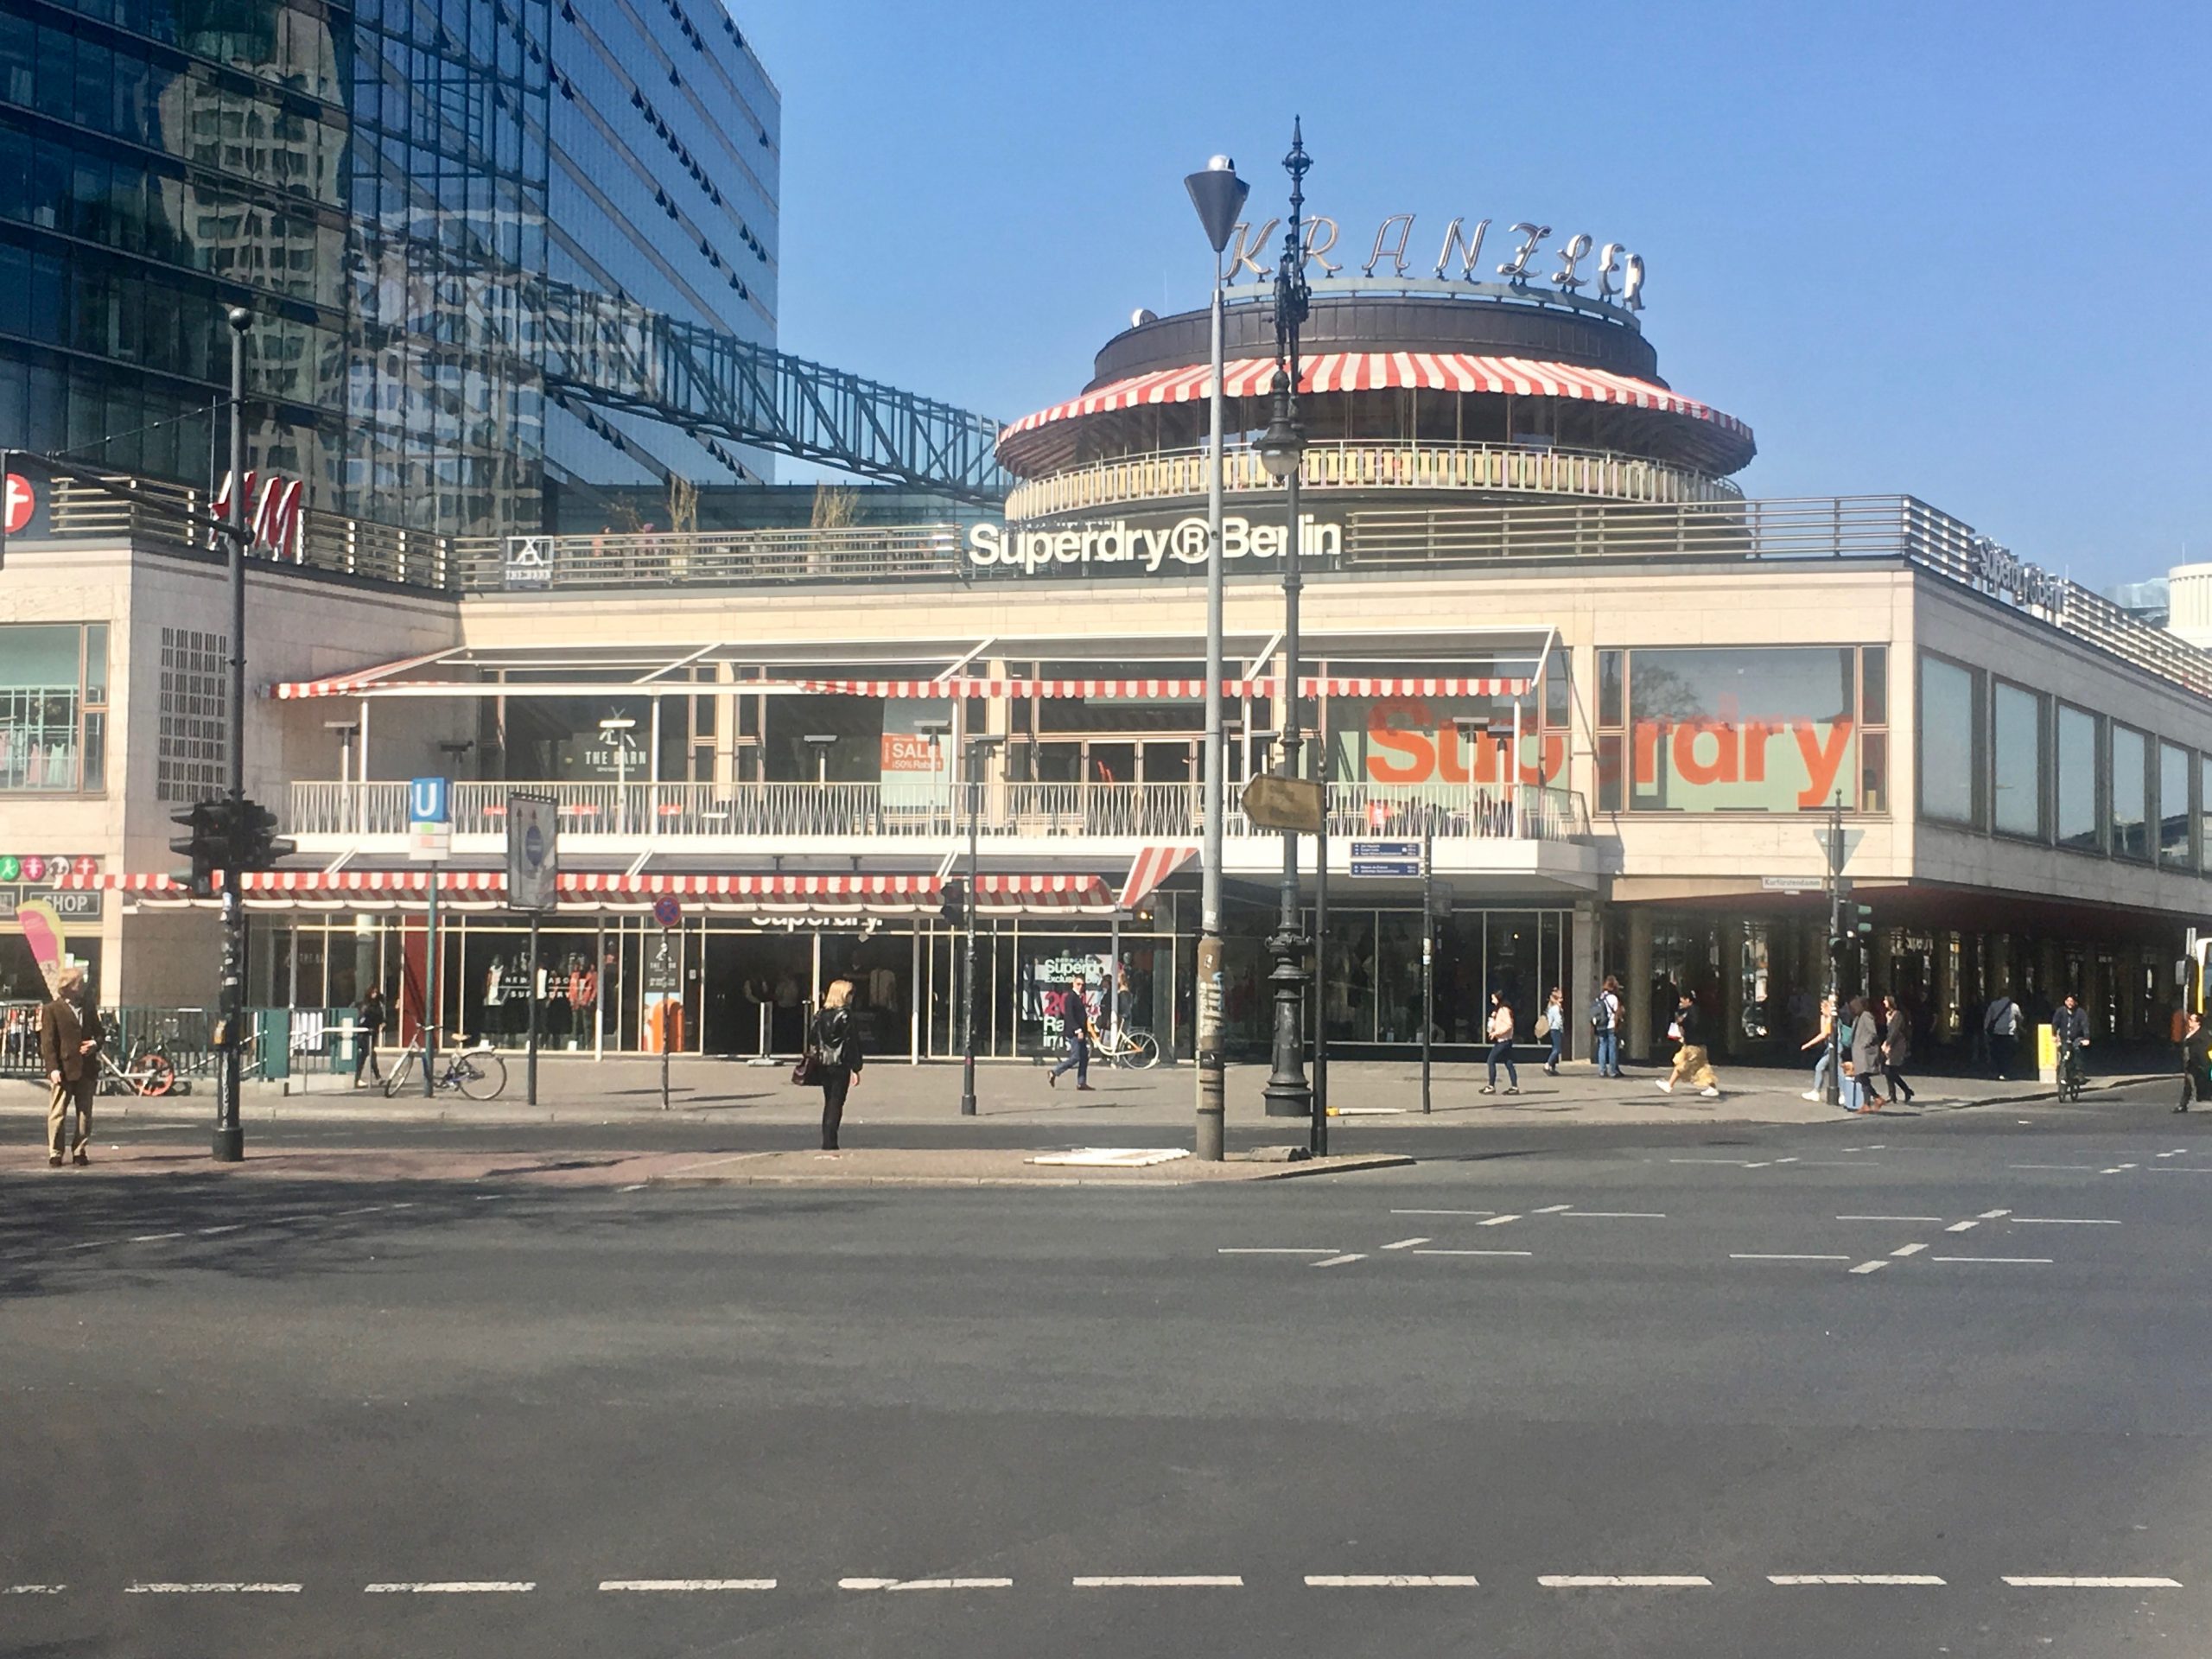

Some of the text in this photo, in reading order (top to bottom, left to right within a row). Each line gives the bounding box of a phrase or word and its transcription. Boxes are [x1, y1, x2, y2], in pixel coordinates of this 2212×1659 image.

[1221, 213, 1646, 310] KRANZLER
[585, 751, 608, 765] THE
[416, 783, 437, 817] U
